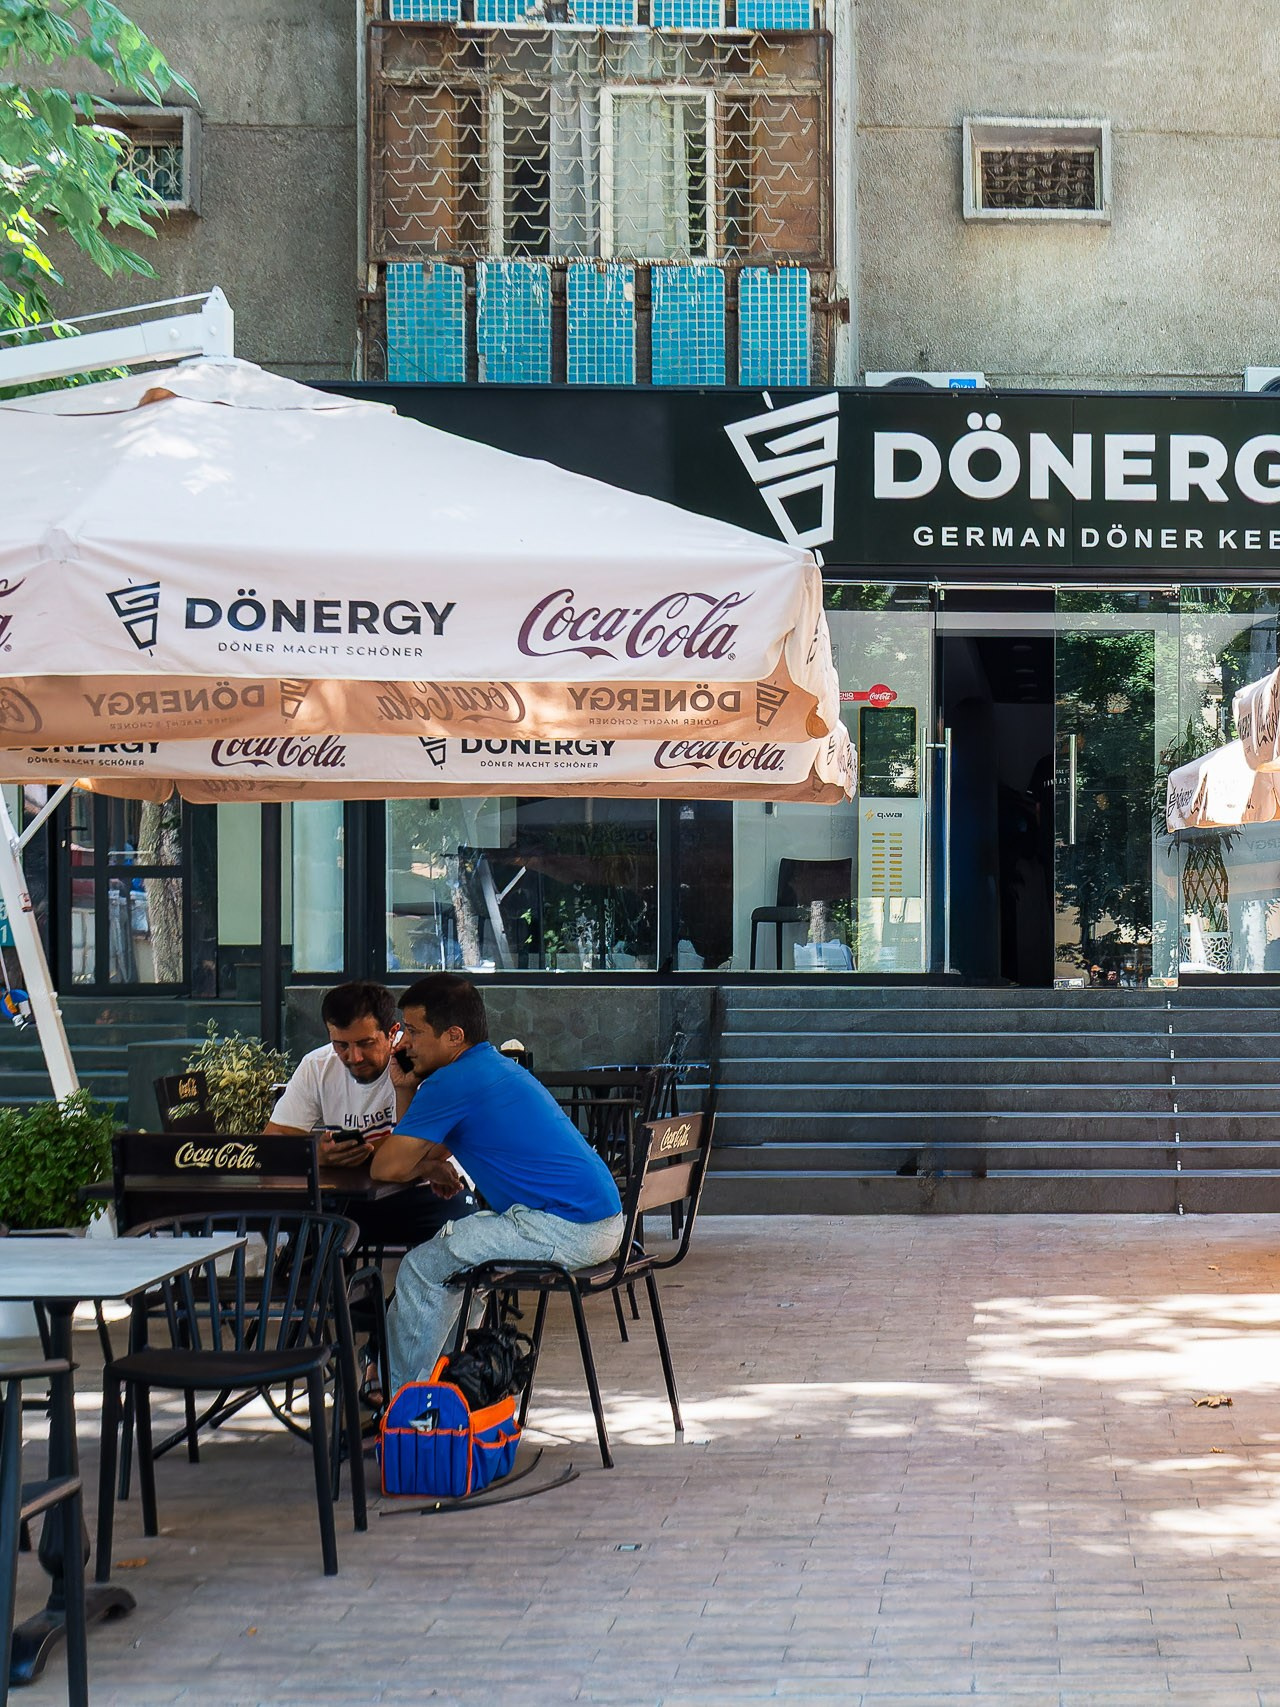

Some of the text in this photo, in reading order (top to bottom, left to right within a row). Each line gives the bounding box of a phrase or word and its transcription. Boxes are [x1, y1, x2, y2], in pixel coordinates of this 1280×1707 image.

[912, 525, 1066, 549] GERMAN
[1080, 524, 1204, 550] DÖNER
[185, 588, 457, 636] DÖNERGY
[517, 588, 756, 661] Coca-Cola
[218, 641, 423, 657] DÖNER MACHT SCHÖNER
[175, 1141, 258, 1169] Coca-Cola
